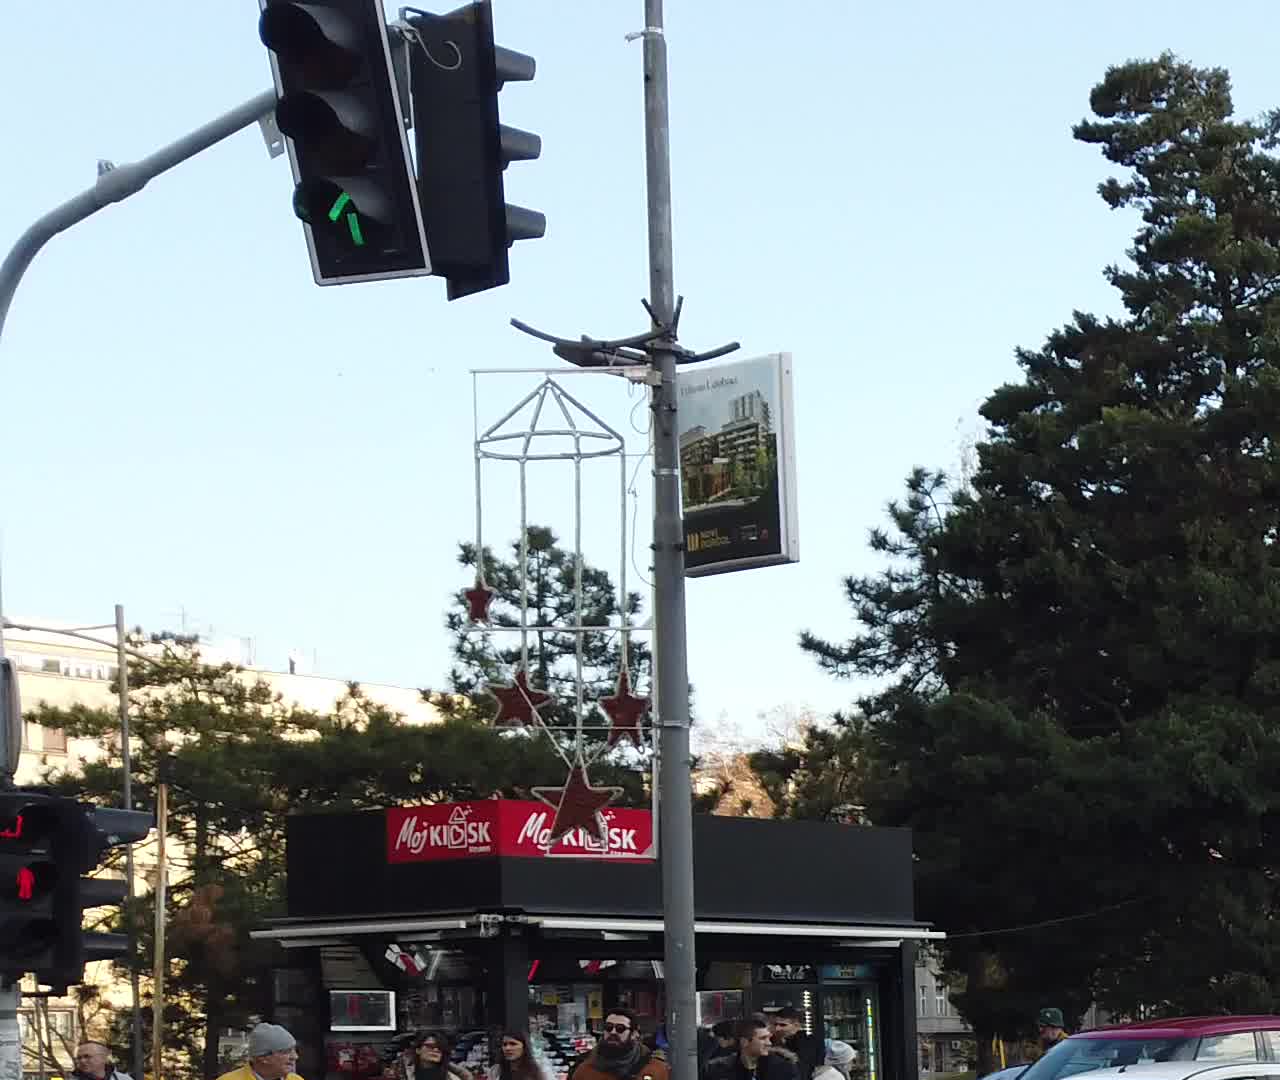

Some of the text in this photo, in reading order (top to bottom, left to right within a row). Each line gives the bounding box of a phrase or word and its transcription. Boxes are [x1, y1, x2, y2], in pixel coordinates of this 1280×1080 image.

[395, 815, 491, 854] Moj KIOSK
[517, 812, 555, 850] Mo
